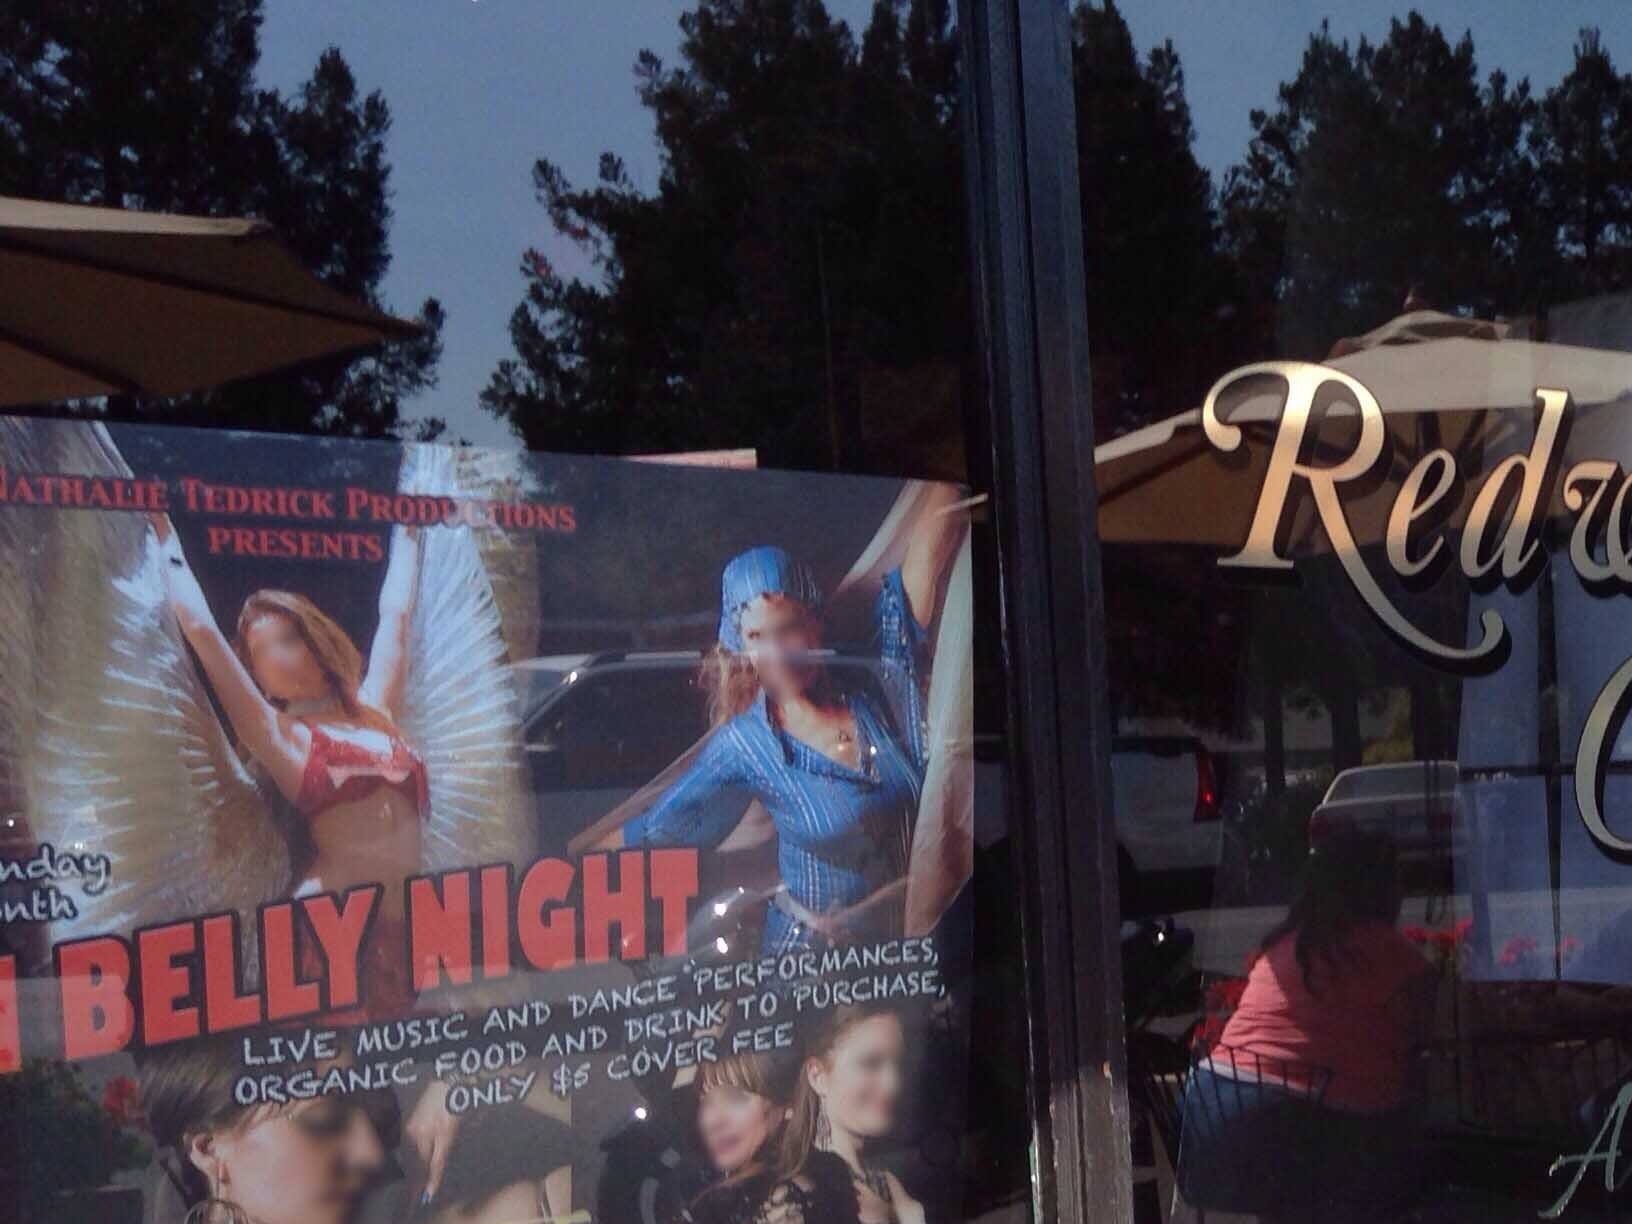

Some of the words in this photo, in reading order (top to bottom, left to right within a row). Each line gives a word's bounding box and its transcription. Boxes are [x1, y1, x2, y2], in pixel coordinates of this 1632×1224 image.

[180, 476, 335, 519] TEDRICK
[346, 487, 577, 532] PRODUCTIONS
[208, 526, 384, 561] PRESENTS
[0, 889, 76, 922] nth
[58, 886, 377, 1061] BELLY
[409, 847, 699, 991] NIGHT
[234, 1057, 418, 1105] ORGANIC
[435, 1040, 527, 1078] FOOD
[543, 1026, 608, 1059] AND
[624, 1003, 725, 1043] DRINK
[736, 990, 777, 1020] TO
[792, 969, 945, 1011] PURCHASE,
[243, 1029, 337, 1066] LIVE
[356, 1013, 468, 1056] MUSIC
[483, 999, 551, 1035] AND
[568, 975, 677, 1019] DANCE
[692, 937, 940, 995] PERFORMANCES,
[448, 1072, 536, 1113] ONLY
[552, 1061, 592, 1097] $5
[606, 1040, 718, 1081] COVER
[731, 1021, 795, 1056] FEE
